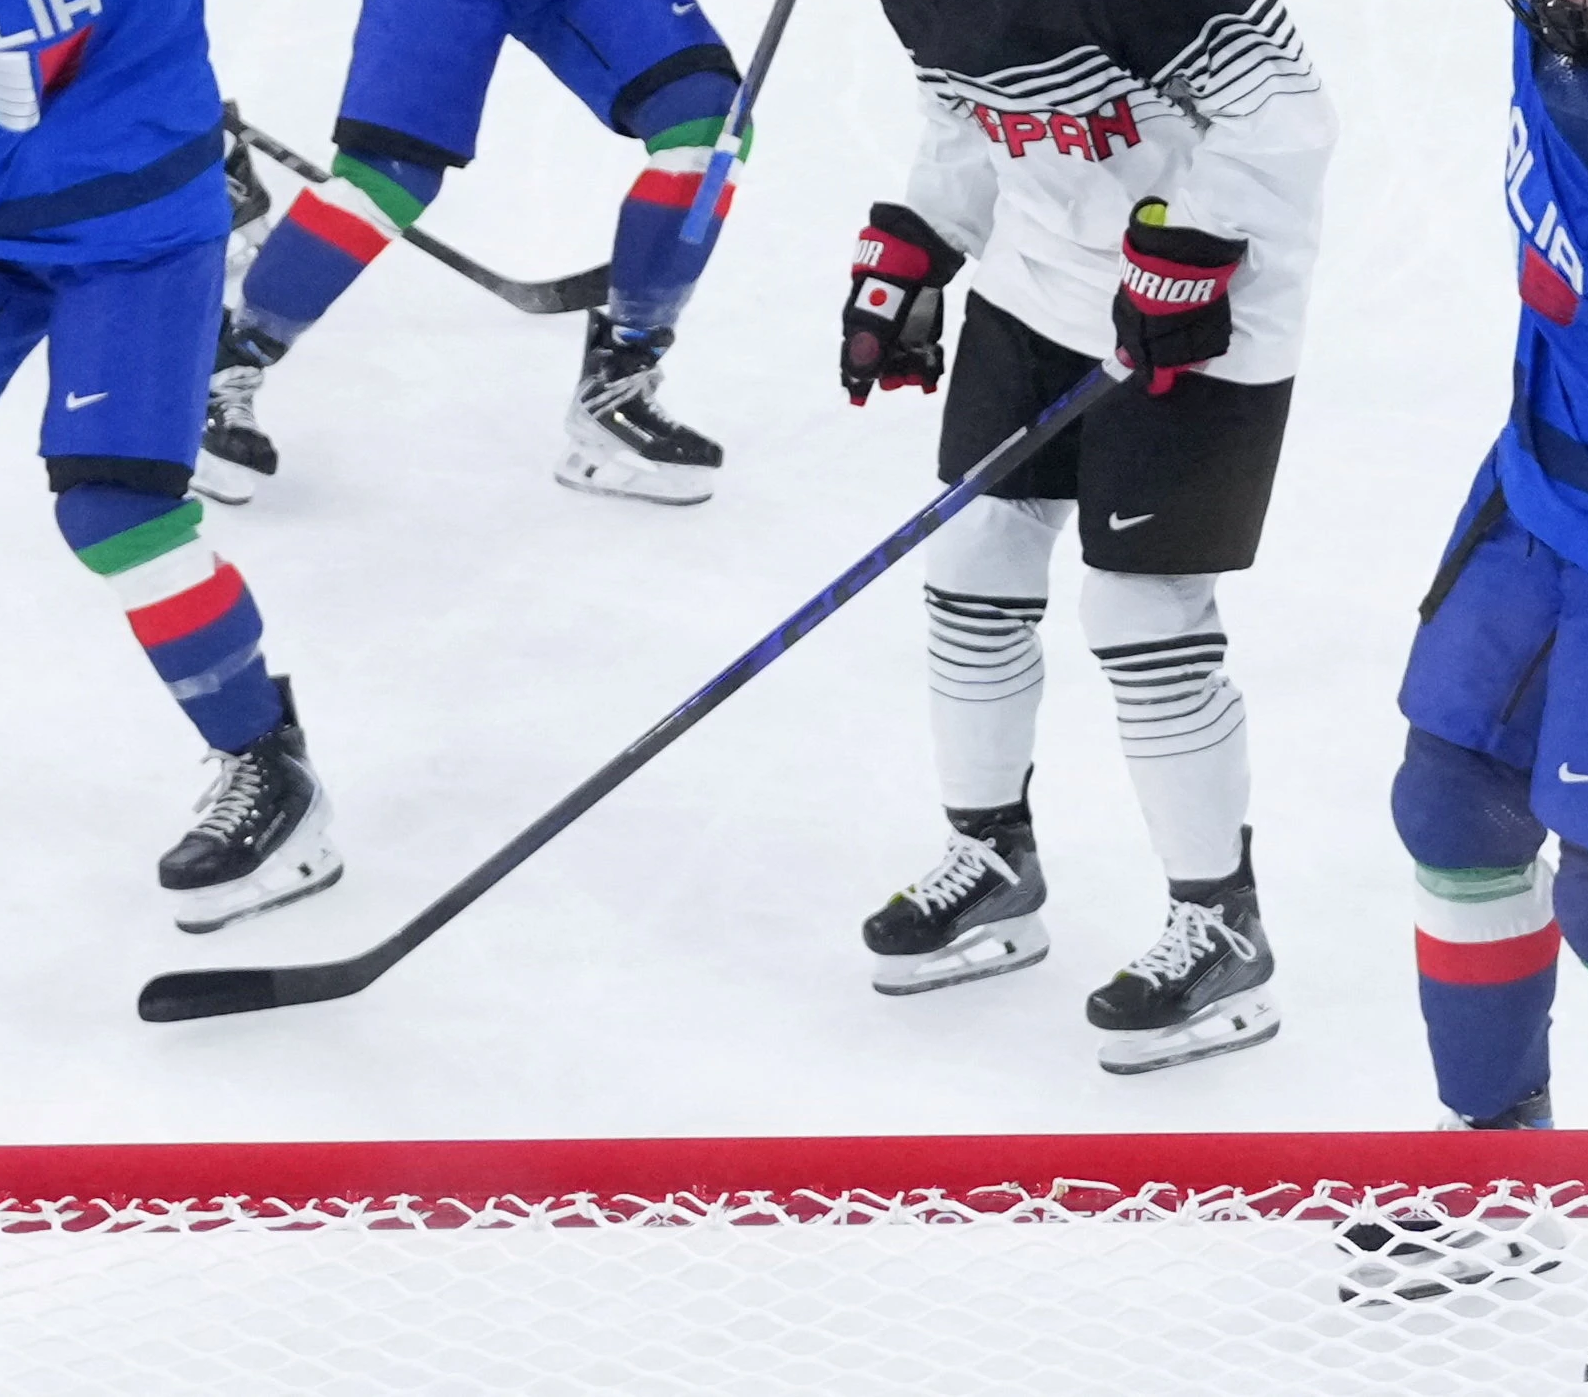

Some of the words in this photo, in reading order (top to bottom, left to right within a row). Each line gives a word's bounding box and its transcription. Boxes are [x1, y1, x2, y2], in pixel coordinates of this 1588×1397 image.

[973, 93, 1142, 163] PAN
[1506, 105, 1584, 296] ALIA
[1119, 257, 1216, 304] RRIOR
